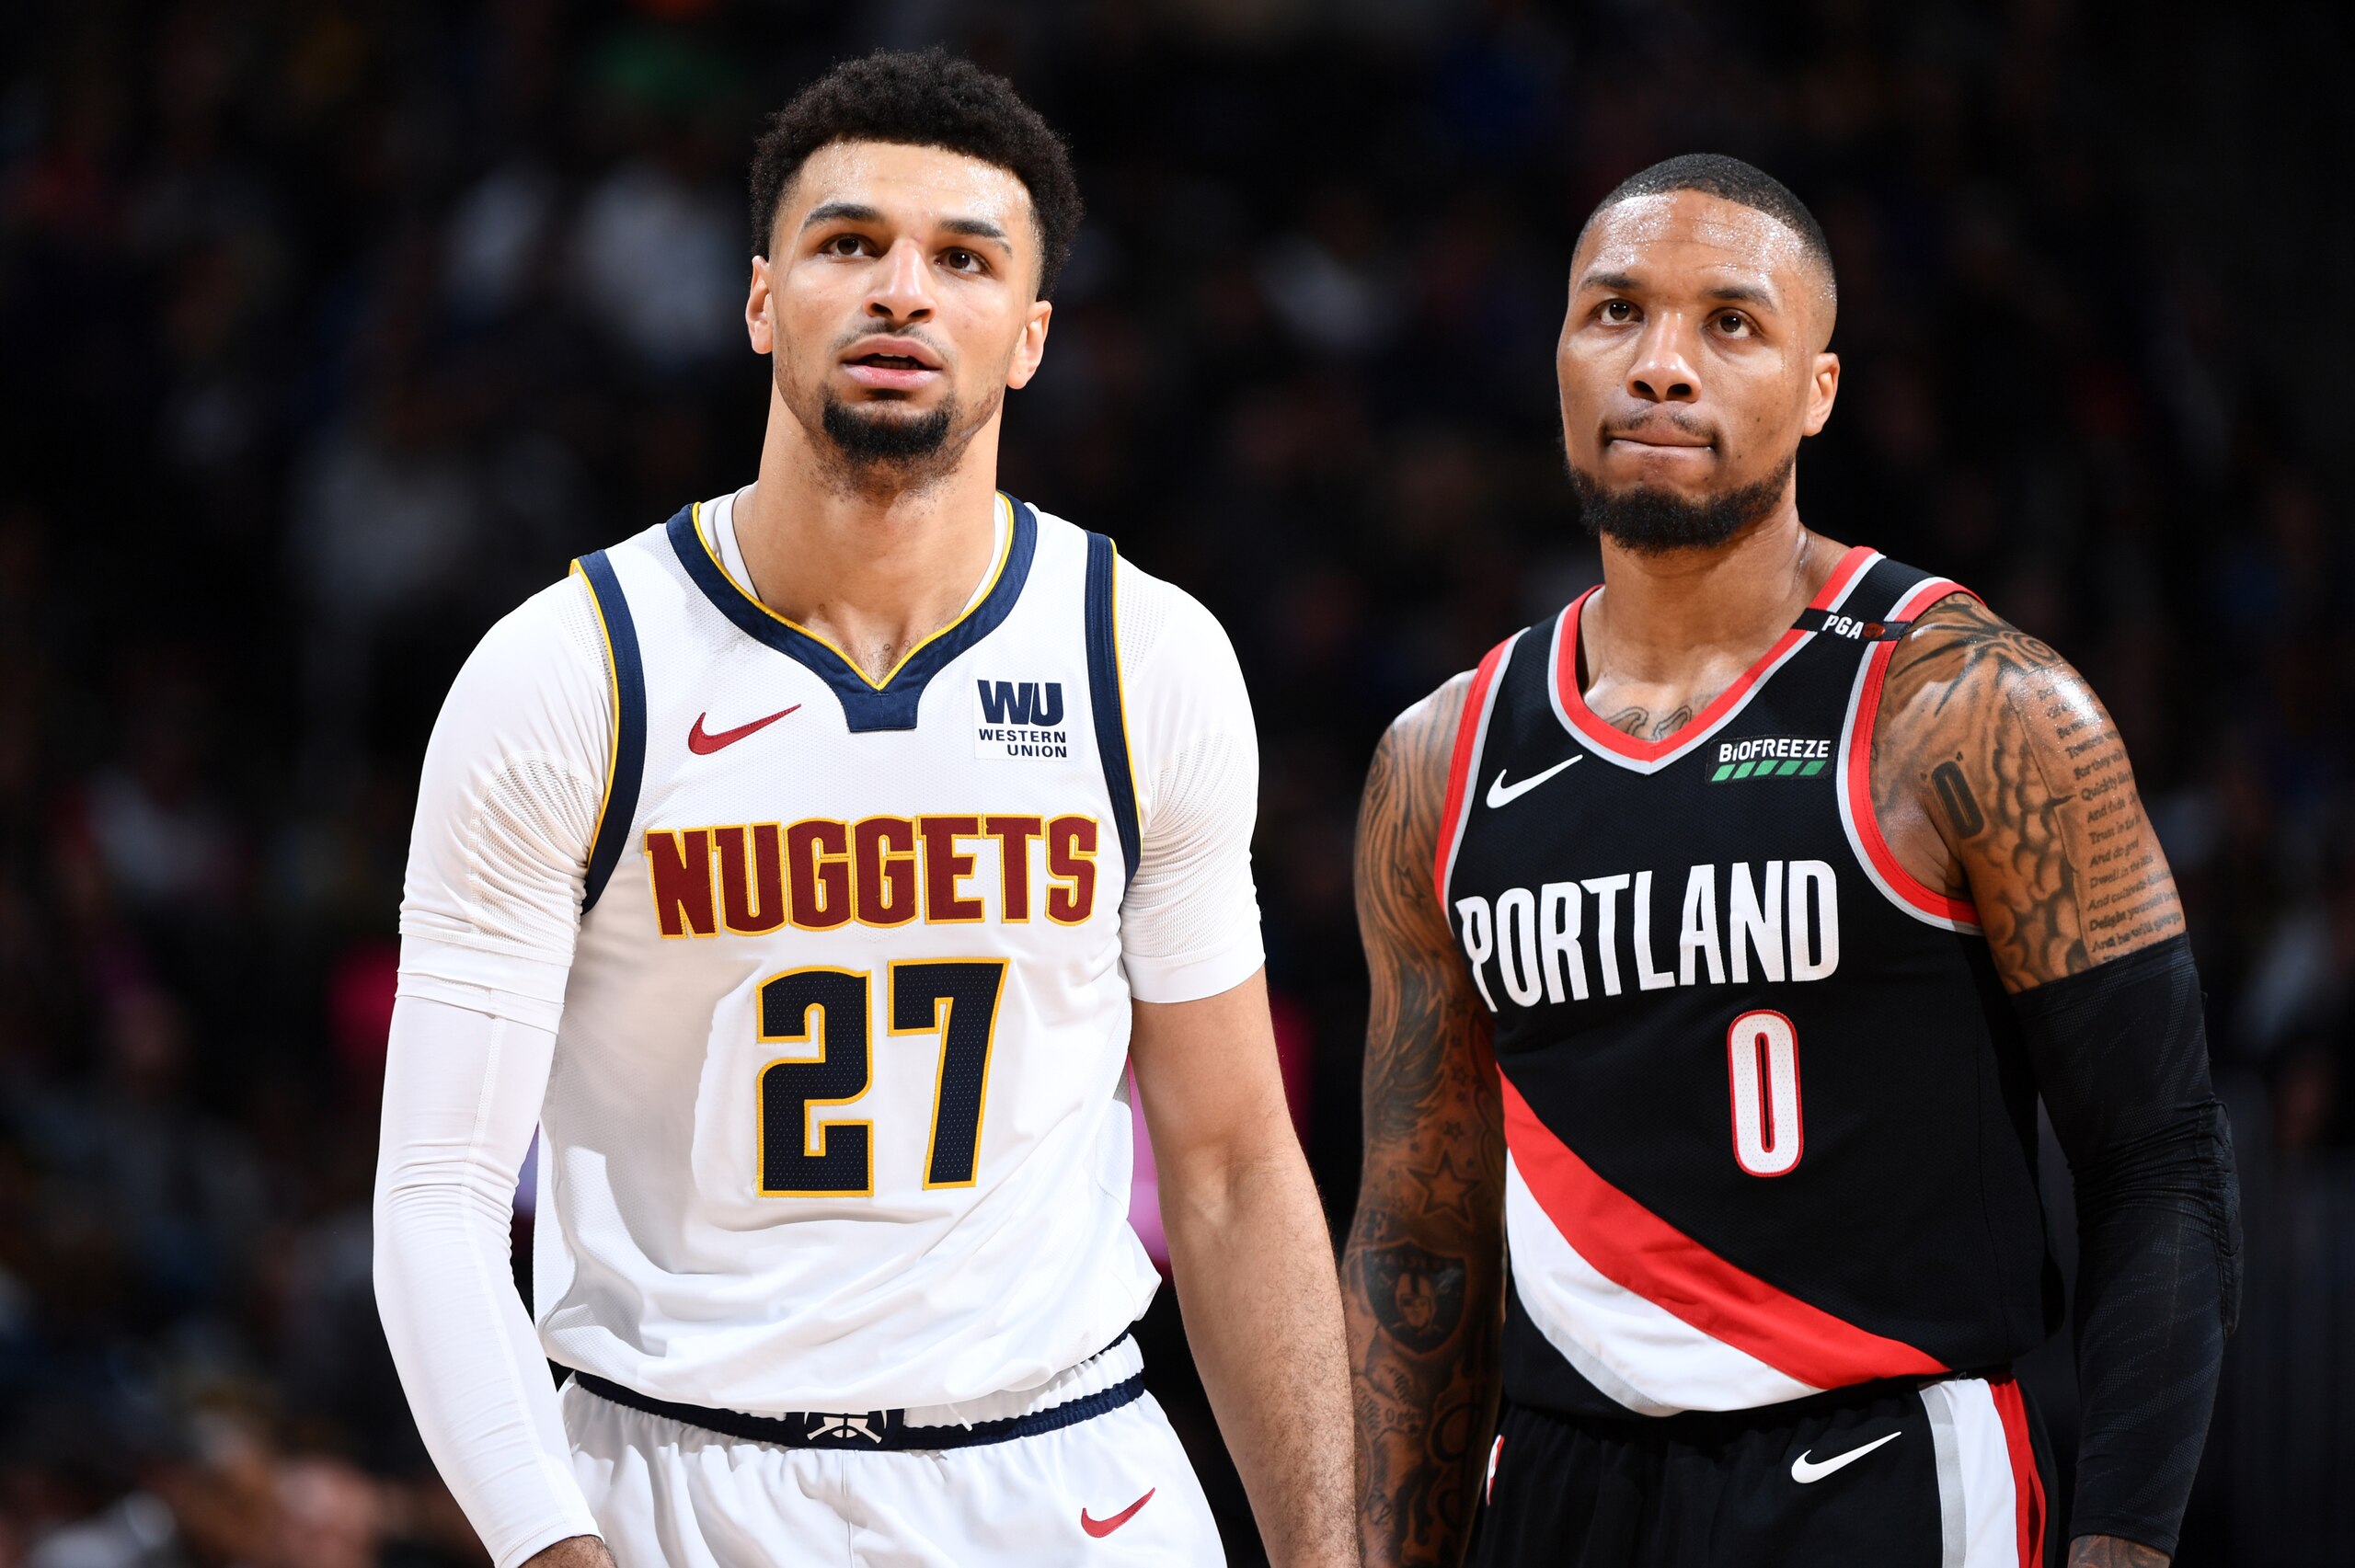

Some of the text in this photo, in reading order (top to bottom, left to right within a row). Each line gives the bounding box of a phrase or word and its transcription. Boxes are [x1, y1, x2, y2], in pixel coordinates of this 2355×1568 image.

[1821, 614, 1864, 640] PGA
[977, 680, 1063, 727] WU
[978, 728, 1066, 743] WESTERN
[1007, 744, 1067, 758] UNION
[2081, 776, 2118, 801] Quickly
[2087, 805, 2108, 824] And
[2088, 849, 2111, 868] And
[644, 814, 1098, 939] NUGGETS
[2090, 868, 2120, 889] Dwell
[2087, 894, 2110, 911] And
[2089, 910, 2126, 933] Delight
[1455, 860, 1839, 1013] PORTLAND
[2092, 935, 2116, 954] And
[755, 957, 1010, 1197] 27
[1727, 1009, 1803, 1178] 0
